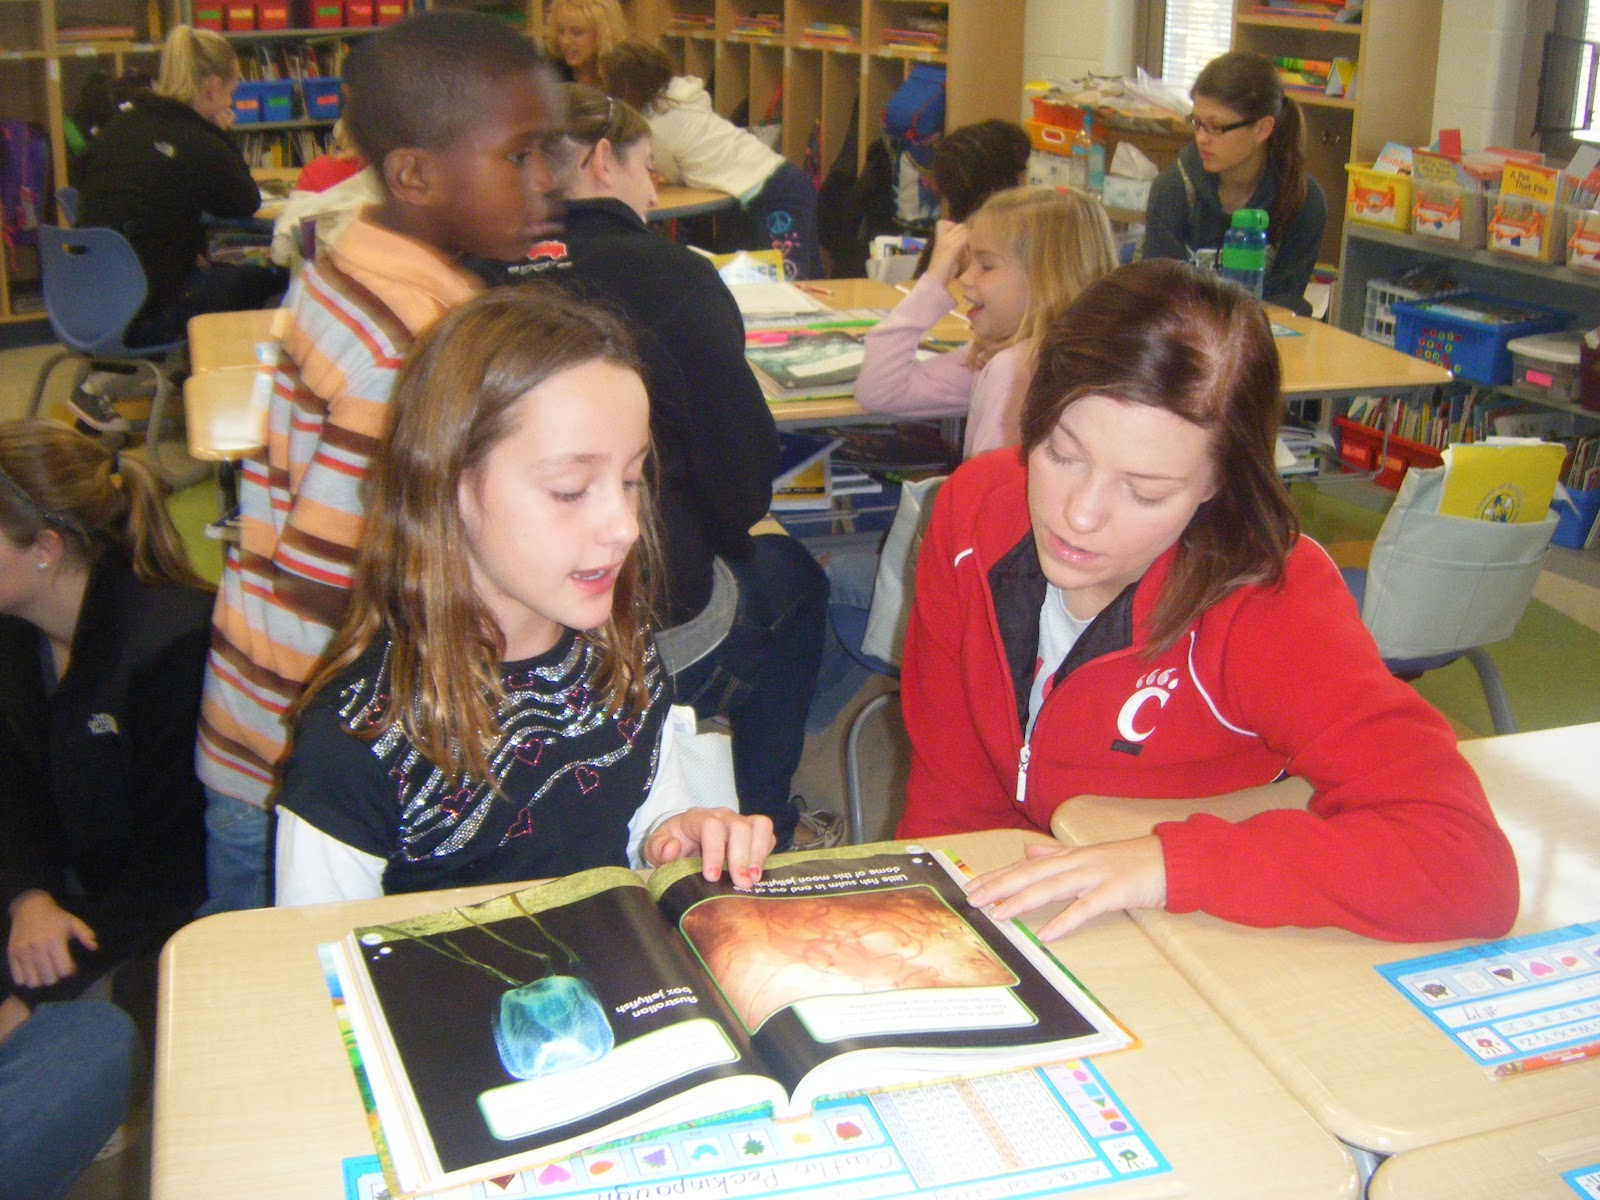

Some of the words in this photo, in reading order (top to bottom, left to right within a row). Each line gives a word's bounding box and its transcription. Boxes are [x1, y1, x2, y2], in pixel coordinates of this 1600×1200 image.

[1510, 170, 1516, 178] A
[1518, 171, 1530, 181] Pet
[1515, 180, 1532, 191] That
[1117, 686, 1170, 742] C
[855, 870, 866, 878] of
[869, 866, 901, 875] dome
[798, 874, 831, 883] moon
[833, 872, 853, 880] this
[881, 873, 908, 883] Little
[828, 880, 858, 889] swim
[859, 877, 880, 886] fish
[790, 885, 811, 894] and
[814, 882, 826, 891] in
[666, 986, 693, 996] box
[615, 989, 665, 1013] jellyfish
[632, 995, 698, 1018] Australian
[795, 1151, 893, 1178] Caitlin
